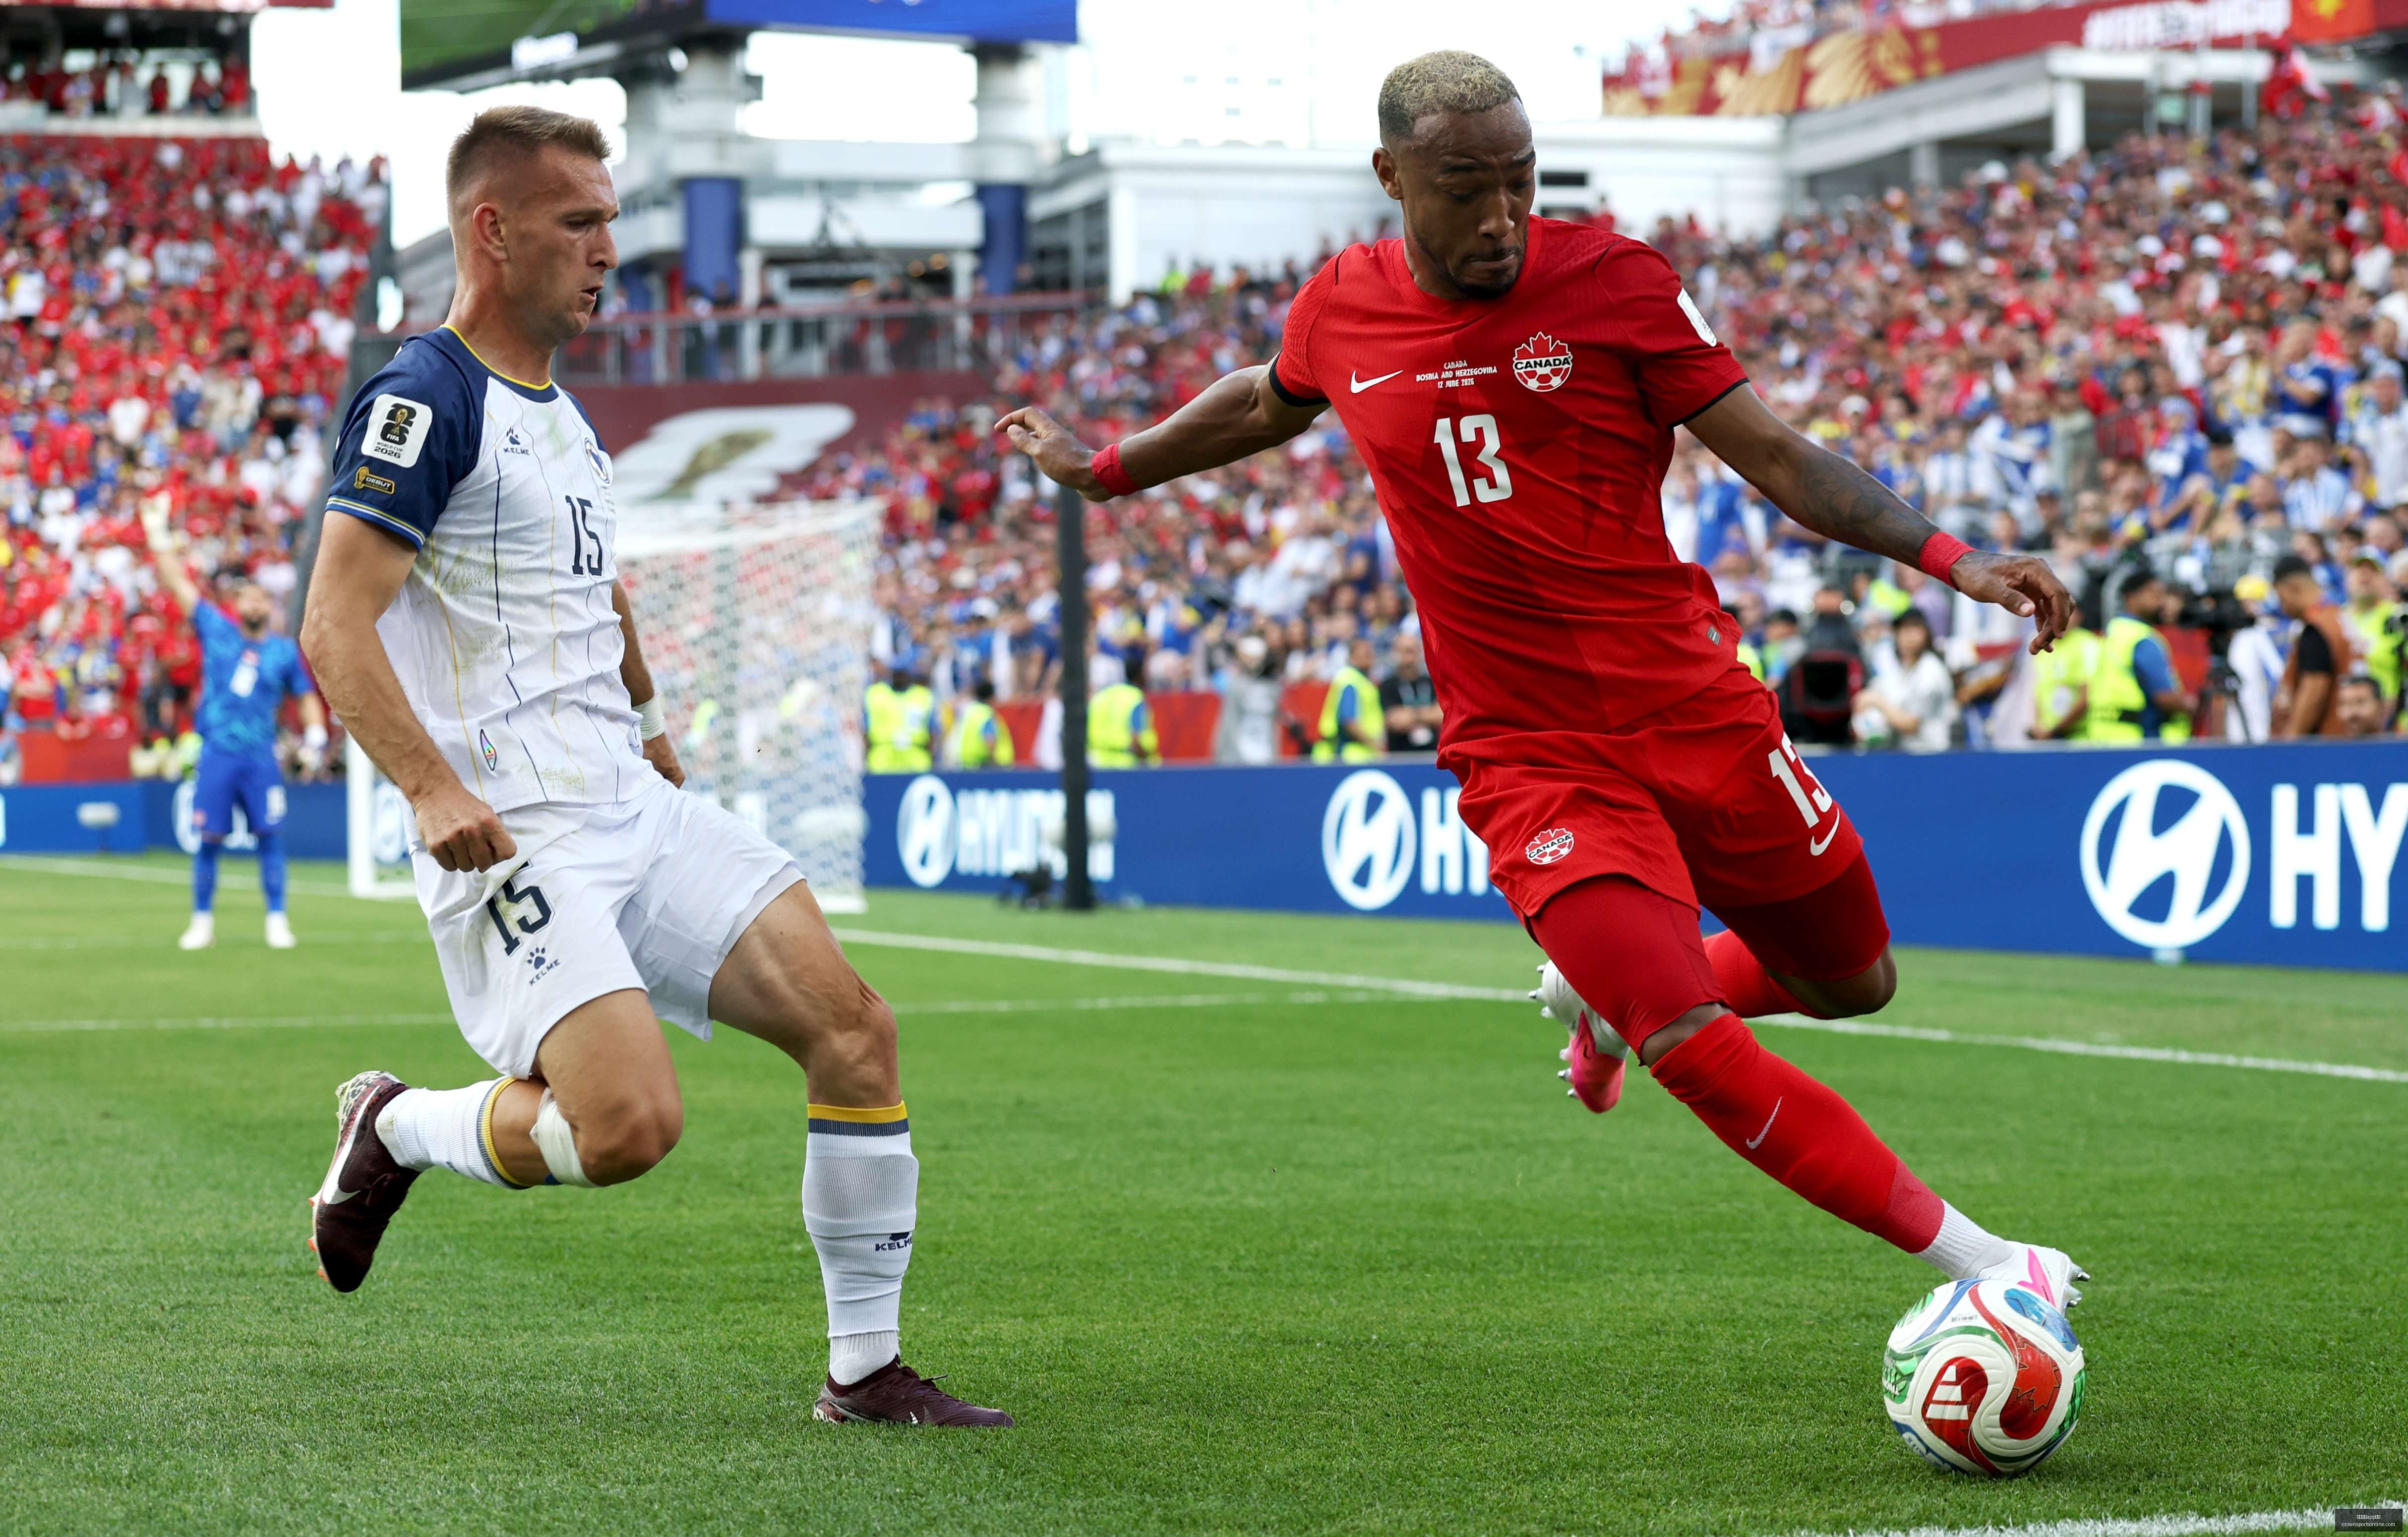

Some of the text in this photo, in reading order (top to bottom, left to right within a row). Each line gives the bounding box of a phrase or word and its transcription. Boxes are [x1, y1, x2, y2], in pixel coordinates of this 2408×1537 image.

[1444, 359, 1468, 369] CANADA
[1514, 357, 1570, 370] CANADA
[1416, 372, 1439, 382] BOSNIA
[1455, 366, 1497, 377] HERZEGOVINA
[1445, 379, 1459, 388] JUNE
[1461, 378, 1474, 386] 2026
[386, 433, 400, 442] FIFA
[374, 446, 401, 459] 2026
[1434, 414, 1512, 507] 13
[365, 477, 391, 487] DEBUT
[565, 495, 603, 577] 15
[1768, 731, 1833, 828] 13
[1529, 835, 1571, 858] CANADA
[486, 860, 554, 956] 15
[529, 959, 561, 986] KELME
